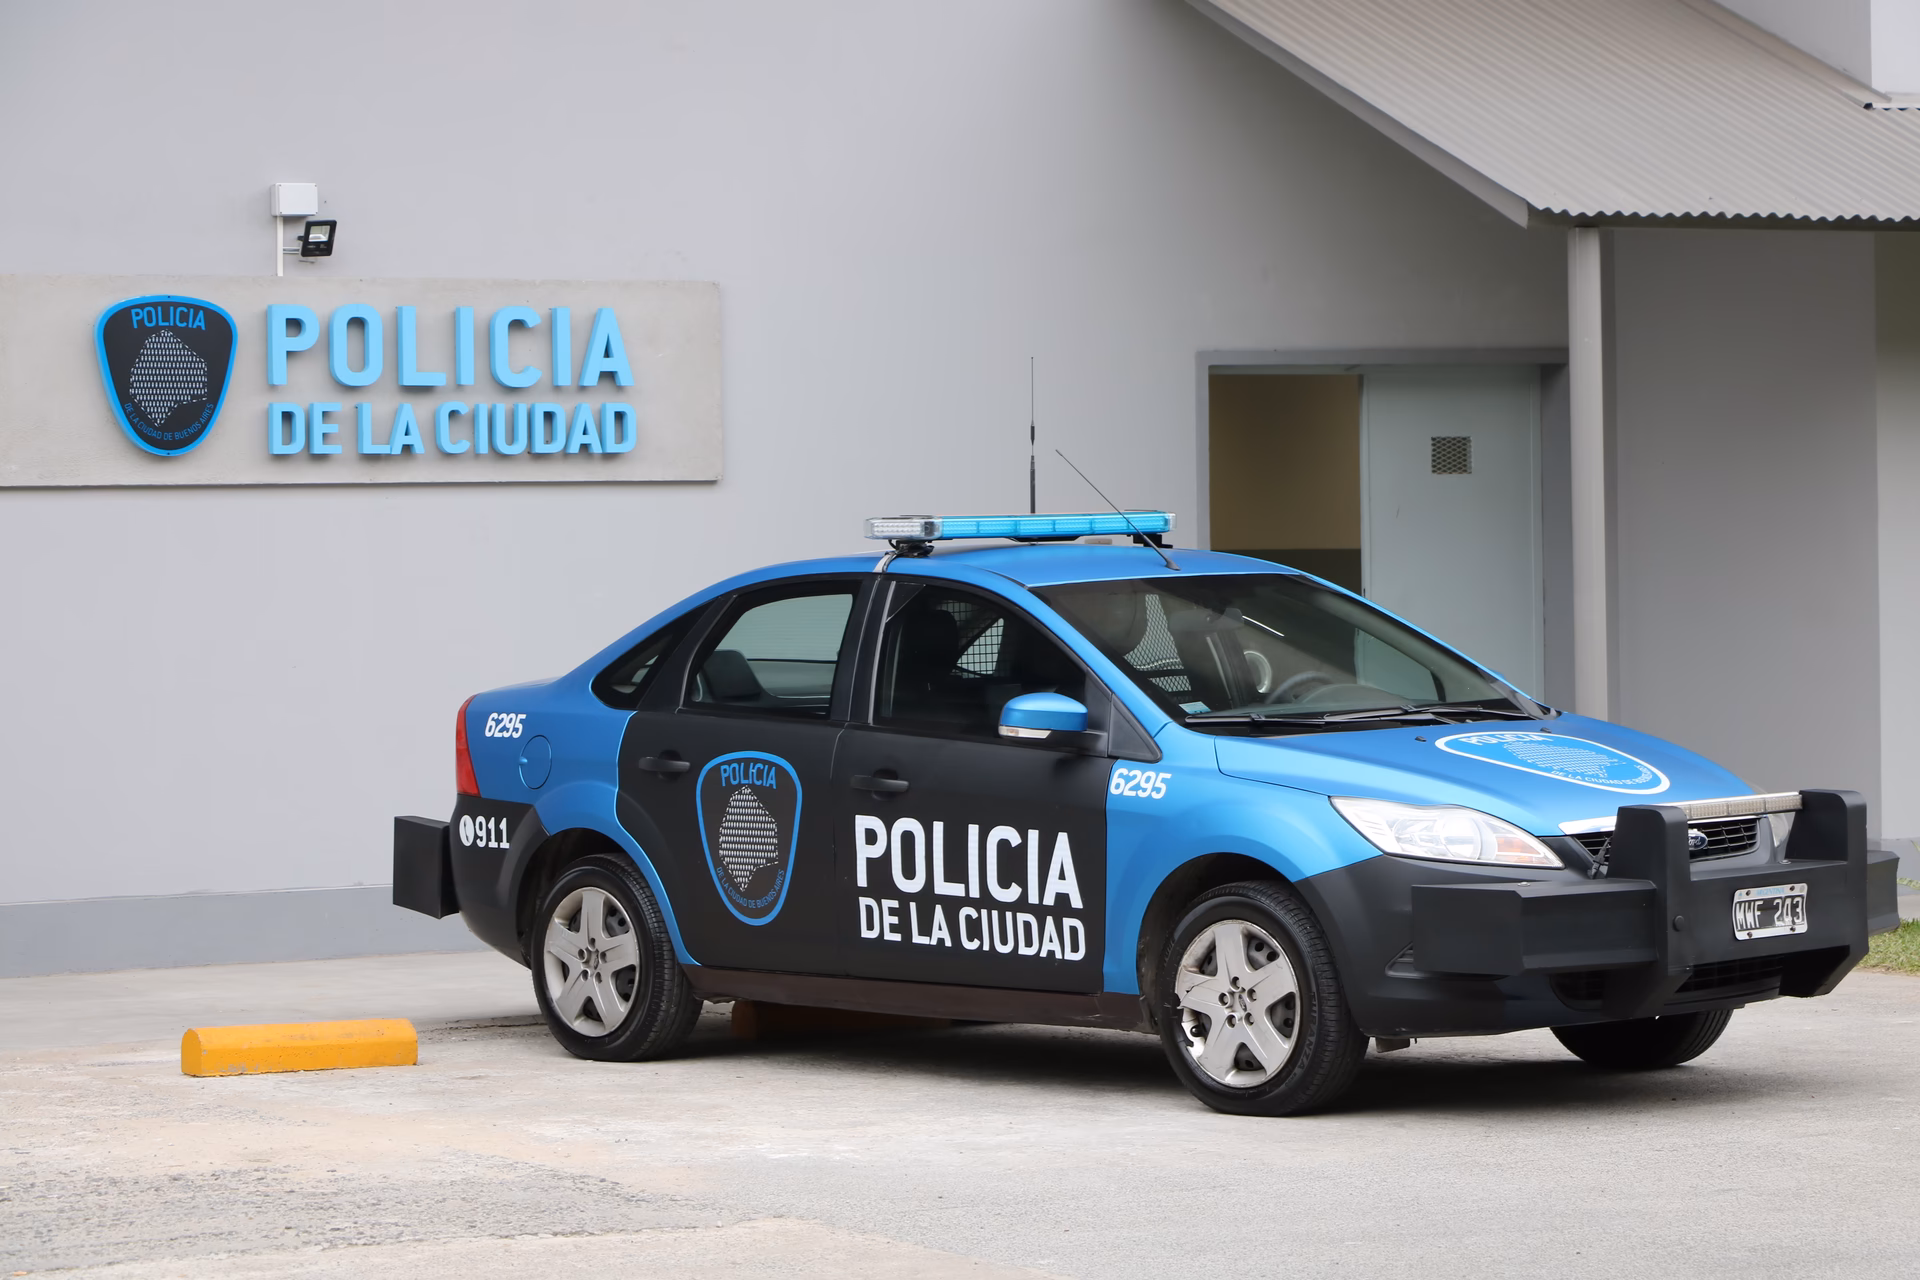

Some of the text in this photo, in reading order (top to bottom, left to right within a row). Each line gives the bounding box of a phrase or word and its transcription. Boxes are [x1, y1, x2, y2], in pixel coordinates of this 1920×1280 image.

[131, 306, 206, 330] POLICIA
[266, 303, 635, 388] POLICIA
[124, 402, 214, 440] DE LA CIUDAD DE BUENOS AIRES
[268, 401, 637, 455] DE LA CIUDAD
[485, 712, 527, 739] 6295
[720, 762, 777, 789] POLICIA
[1110, 767, 1172, 799] 6295
[1568, 773, 1583, 781] LA
[475, 815, 510, 849] 911
[855, 814, 1083, 909] POLICIA
[716, 867, 785, 908] DE LA CIUDAD DE BUENOS AIRES
[858, 896, 1086, 961] DE LA CIUDAD
[1736, 896, 1803, 931] MWF 243
